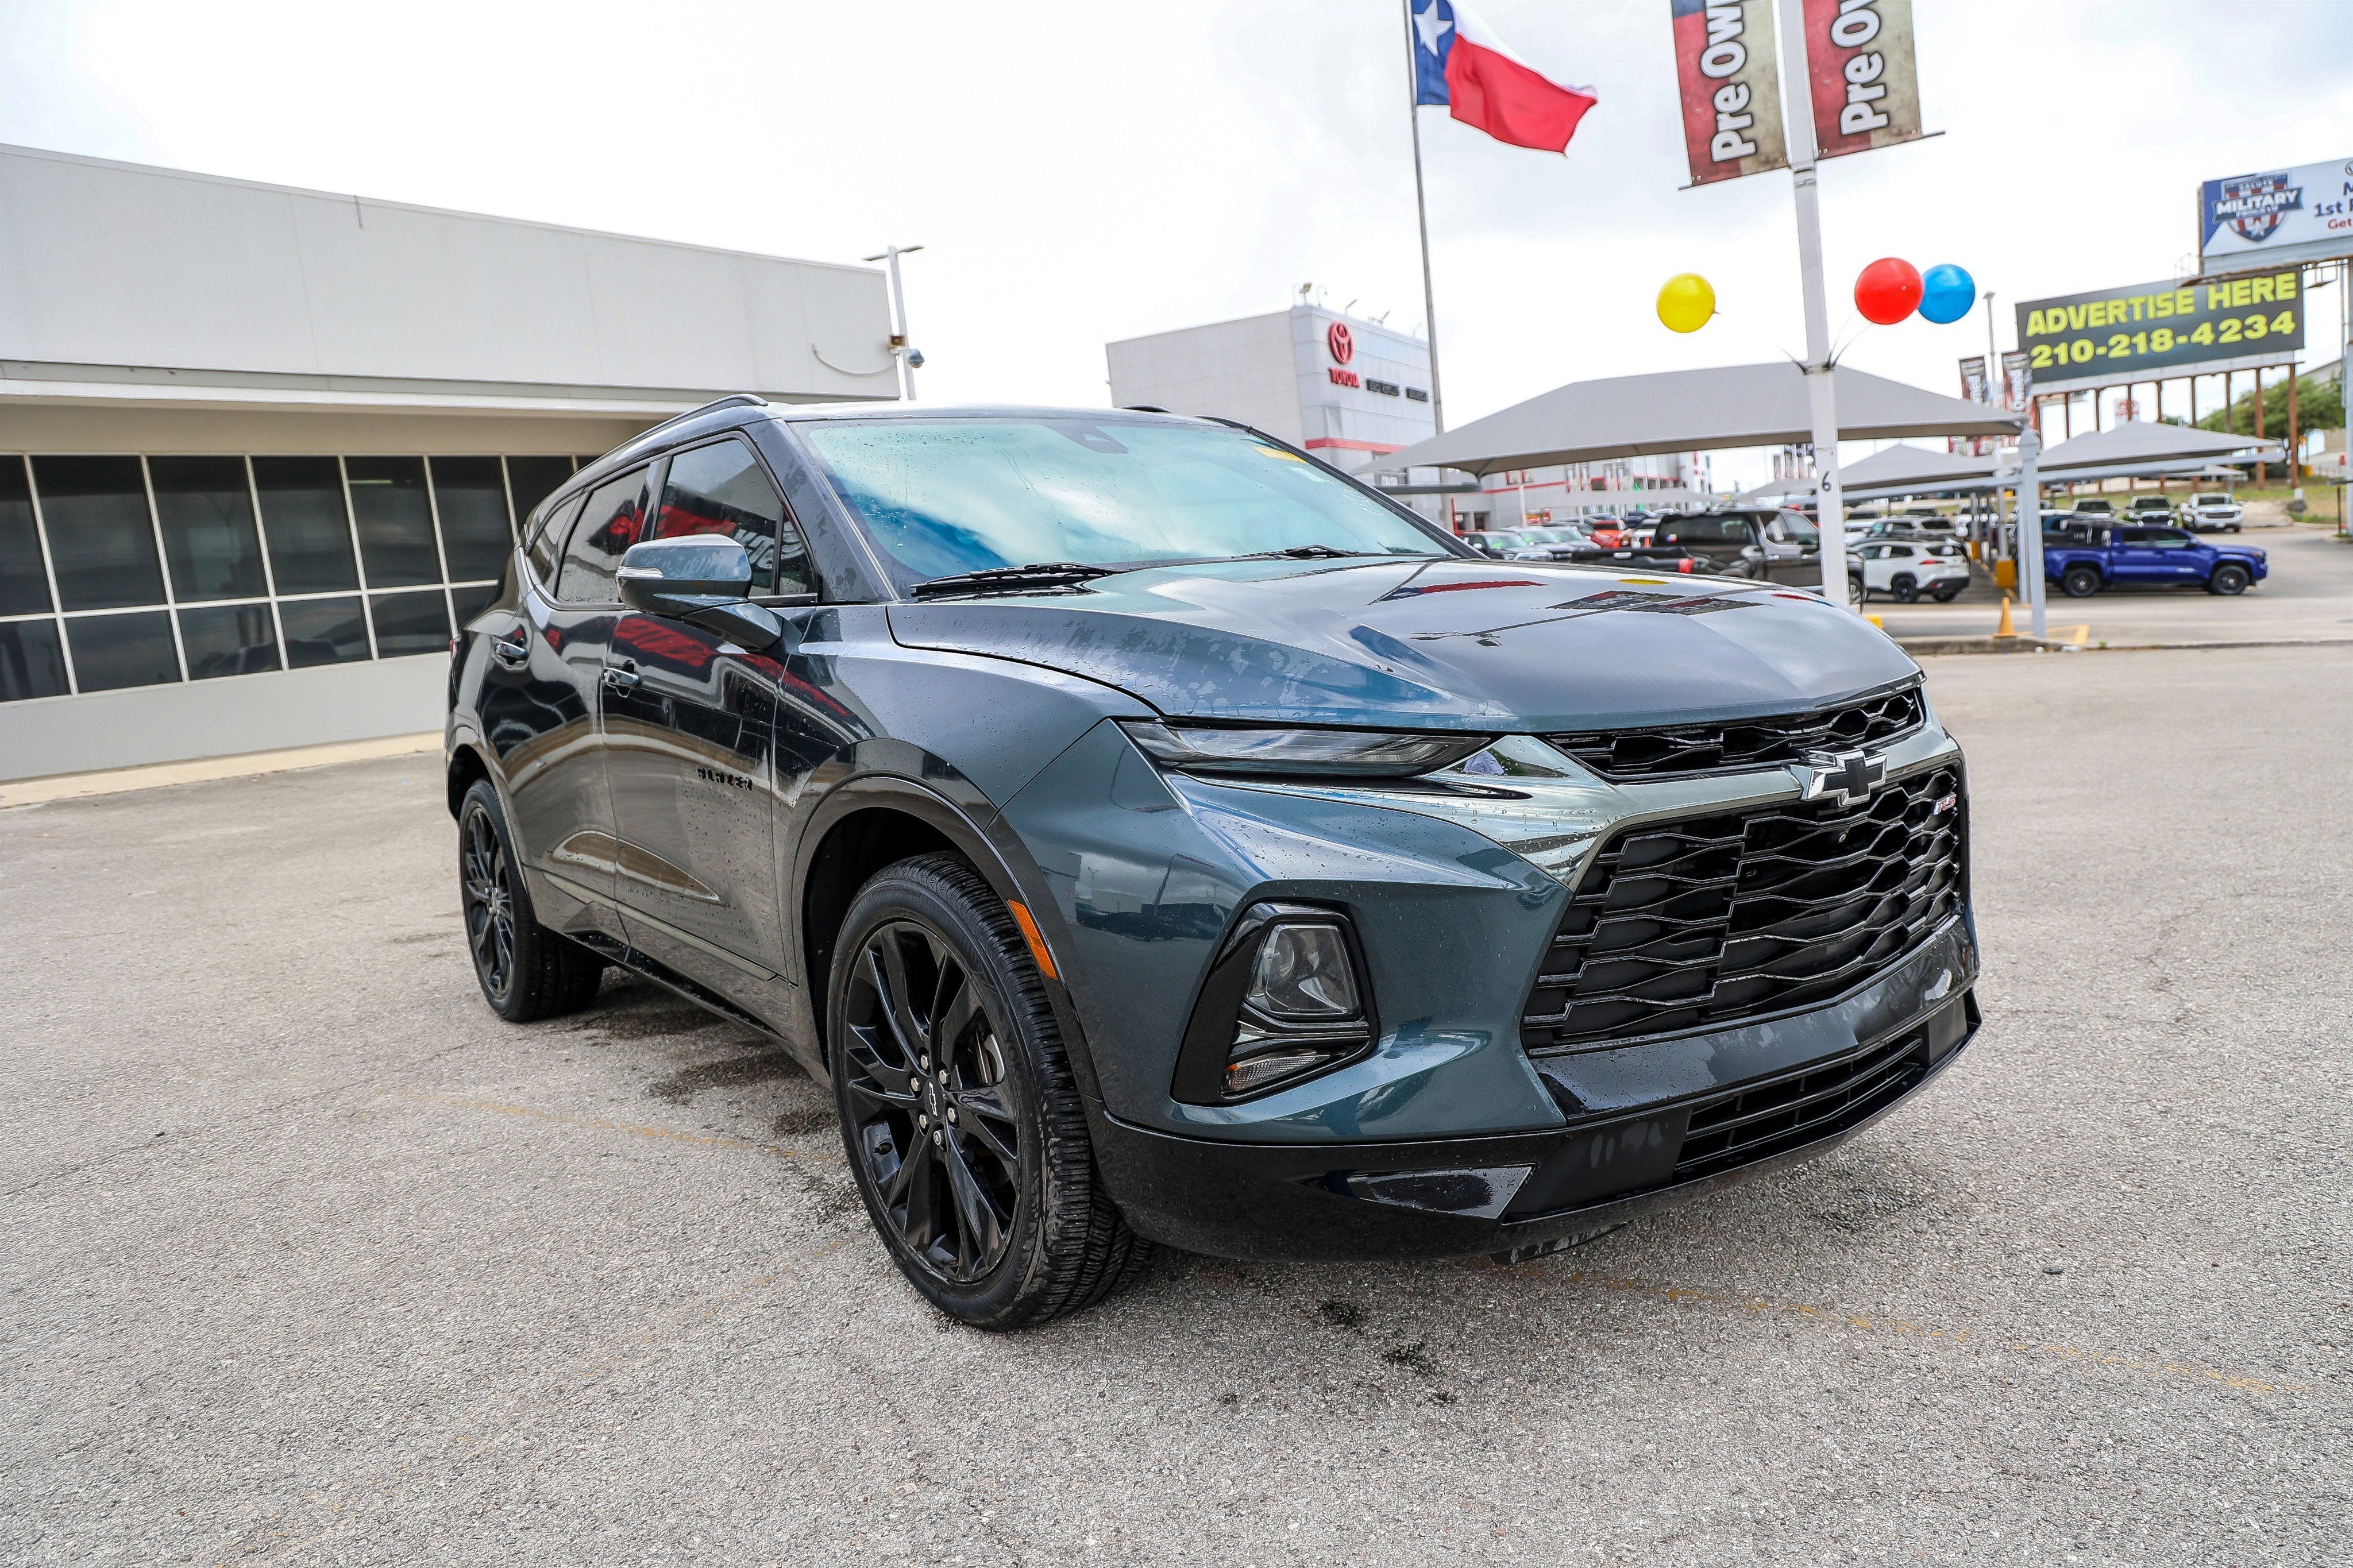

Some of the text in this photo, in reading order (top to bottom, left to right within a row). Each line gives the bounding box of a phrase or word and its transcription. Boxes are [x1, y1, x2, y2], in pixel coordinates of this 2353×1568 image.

[1839, 52, 1889, 136] Pre
[1710, 82, 1757, 163] Pre
[2215, 188, 2299, 215] MILITARY
[2314, 200, 2343, 217] 1st
[2025, 272, 2297, 337] ADVERTISE HERE
[2029, 311, 2296, 369] 210-218-4234
[1820, 470, 1833, 492] 6
[1934, 793, 1957, 815] RS
